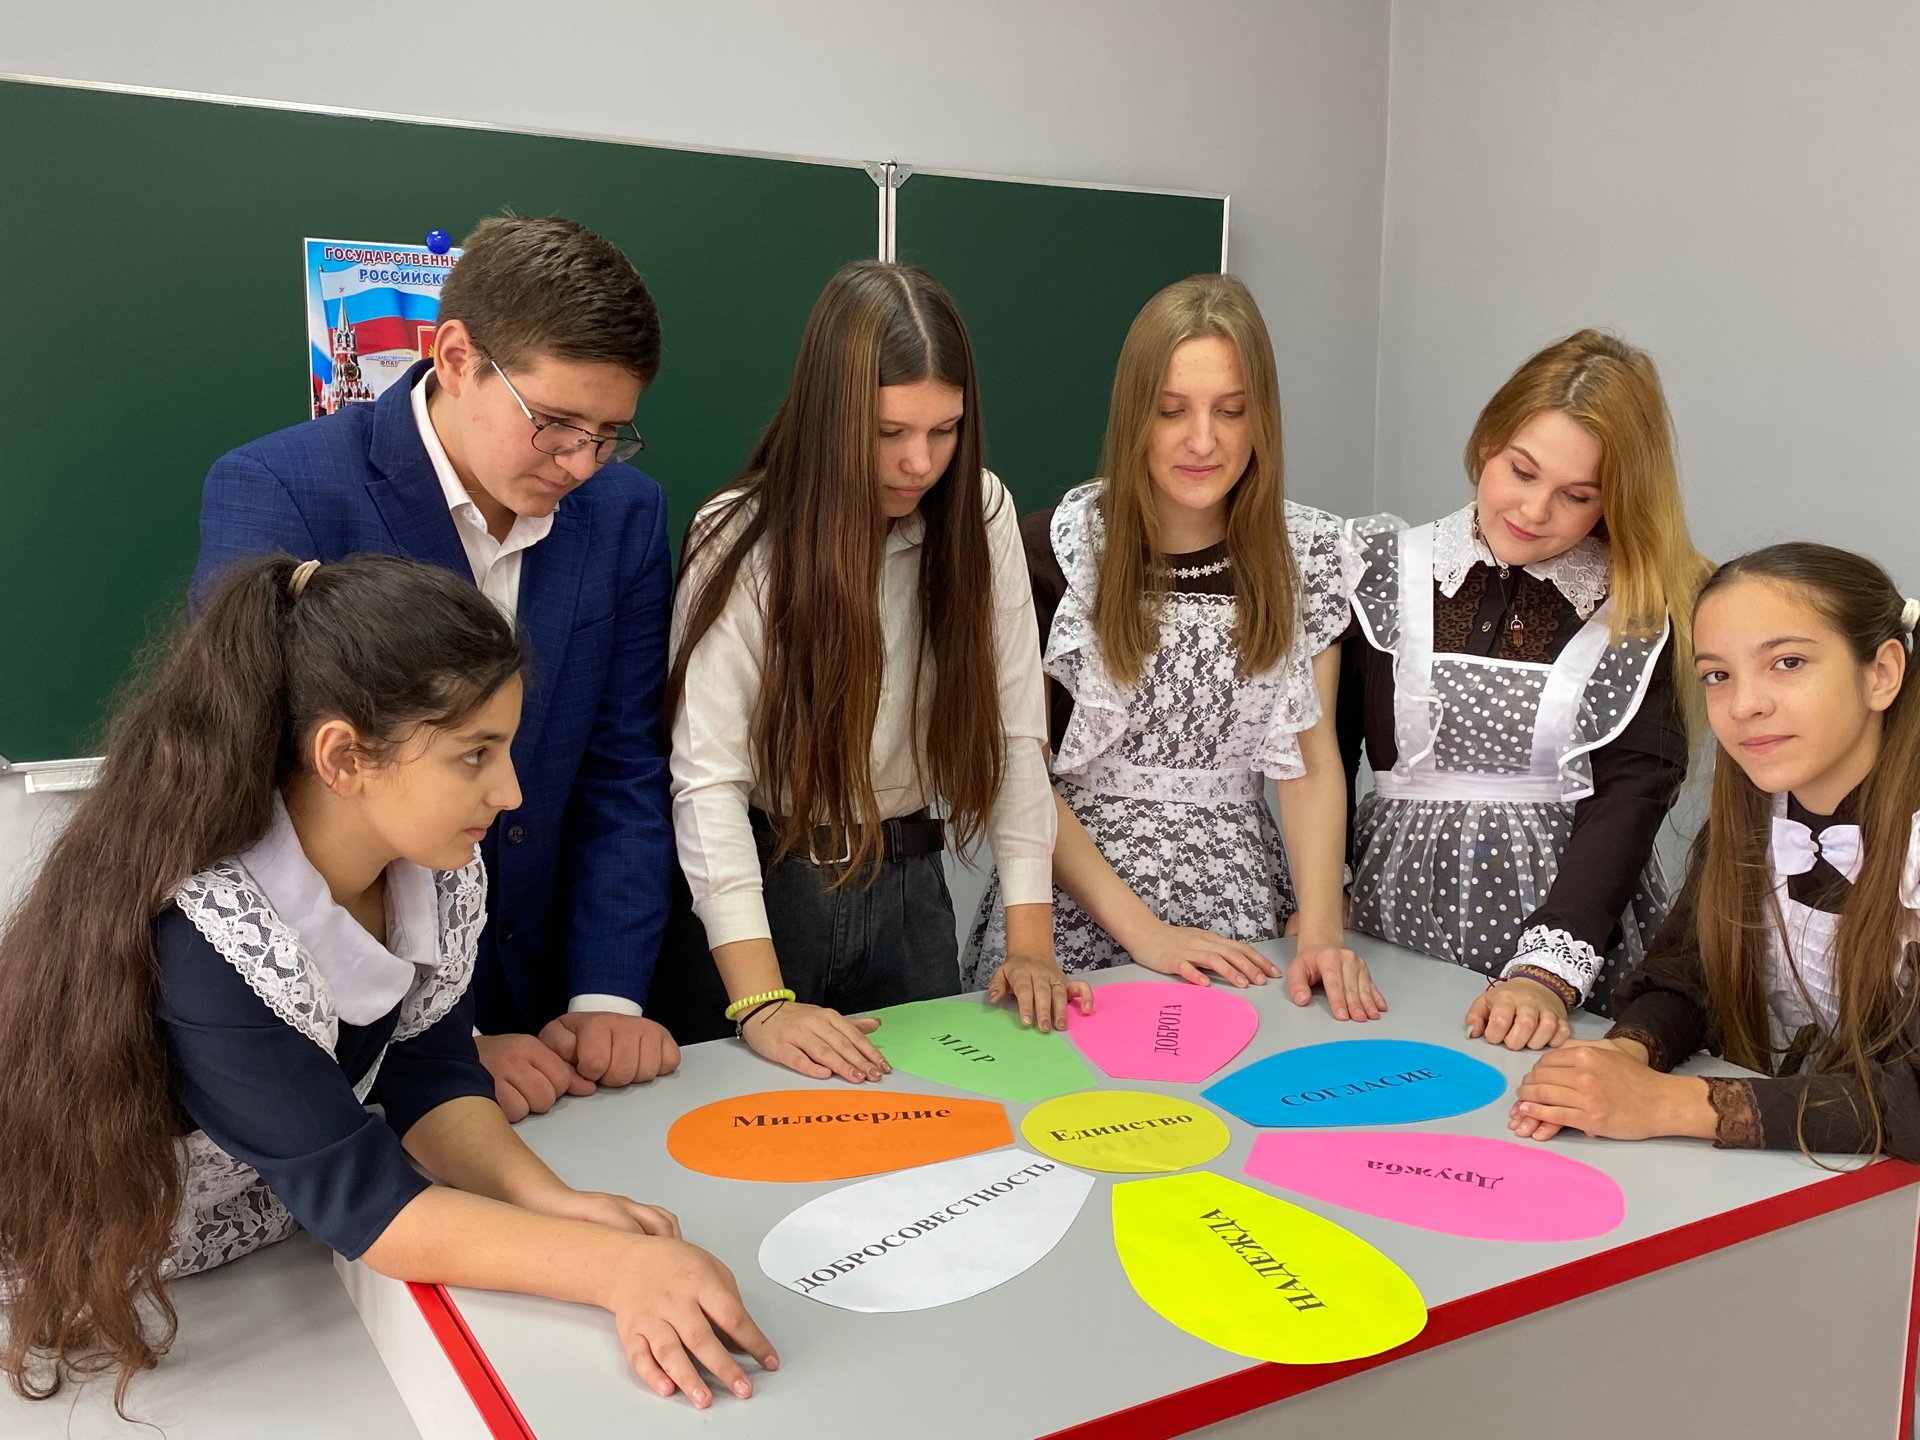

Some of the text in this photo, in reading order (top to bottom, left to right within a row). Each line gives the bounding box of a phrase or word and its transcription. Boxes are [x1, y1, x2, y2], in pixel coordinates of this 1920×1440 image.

[1154, 1004, 1181, 1056] ДОБРОТА
[932, 1033, 995, 1062] МИР
[1281, 1069, 1442, 1106] СОГЛАСИЕ
[733, 1109, 951, 1128] Милосердие
[1050, 1114, 1193, 1142] Единство
[1366, 1160, 1503, 1190] Дружба
[793, 1161, 1056, 1294] ДОБРОСОВЕСТНОСТЬ
[1199, 1208, 1327, 1313] НАДЕЖДА
